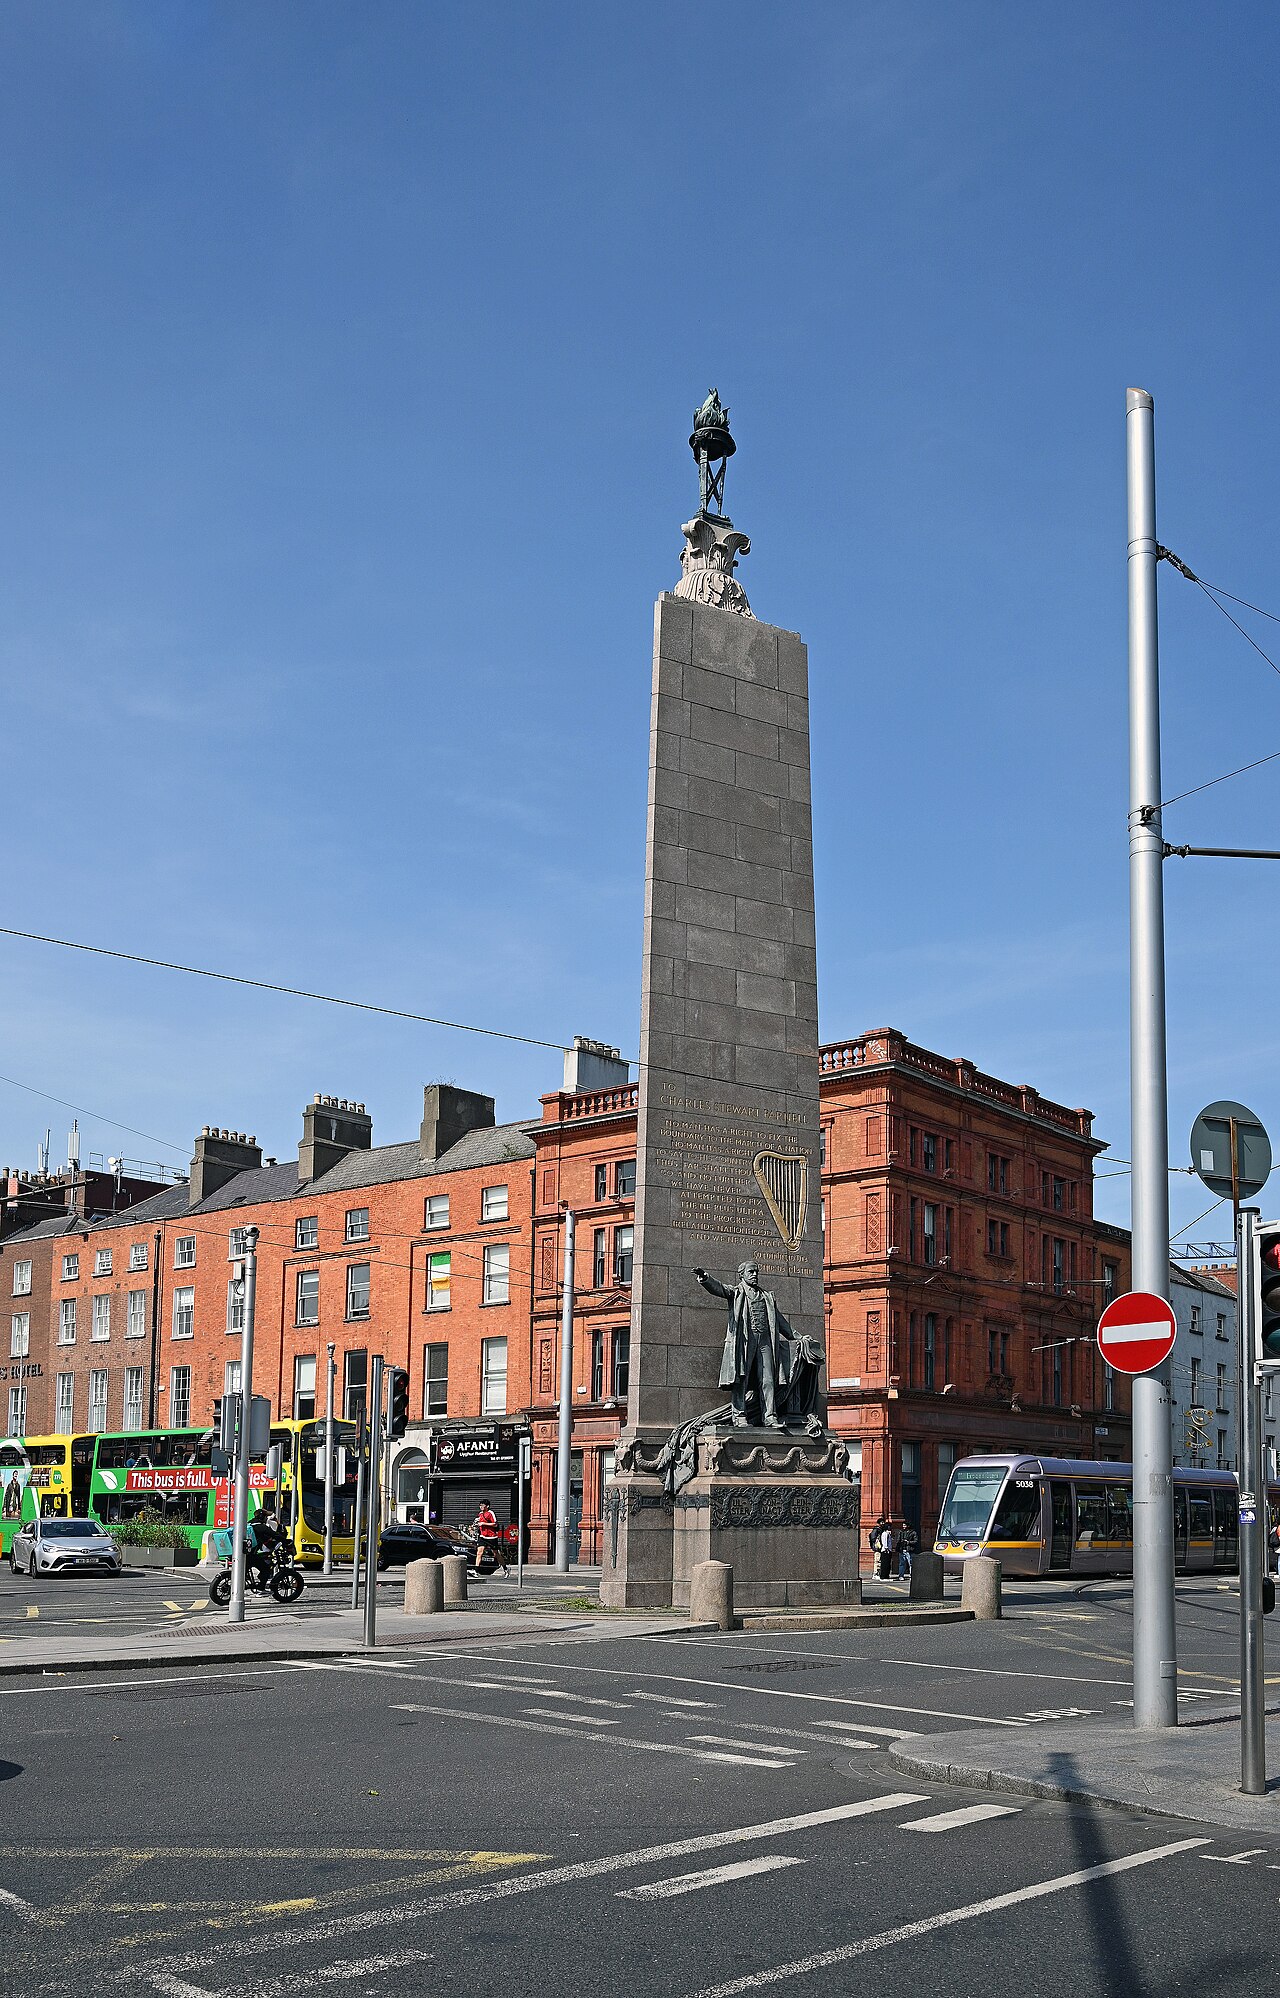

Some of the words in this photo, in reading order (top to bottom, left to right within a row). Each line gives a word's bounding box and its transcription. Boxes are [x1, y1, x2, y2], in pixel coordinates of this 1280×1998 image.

[662, 1082, 676, 1092] TO
[660, 1095, 711, 1110] CHARLES
[714, 1102, 760, 1117] STEWART
[764, 1108, 808, 1123] PARNELL
[665, 1120, 680, 1128] NO
[681, 1121, 701, 1130] MAN
[704, 1124, 720, 1133] HAS
[730, 1128, 753, 1137] RIGHT
[756, 1131, 767, 1139] TO
[768, 1132, 782, 1141] FIX
[784, 1134, 798, 1143] THE
[660, 1128, 705, 1141] BOUNDARY
[708, 1135, 718, 1143] TO
[719, 1136, 734, 1145] THE
[735, 1139, 762, 1148] MARCH
[764, 1142, 775, 1150] OF
[785, 1146, 812, 1155] NATION
[656, 1148, 667, 1156] TO
[686, 1142, 705, 1151] MAN
[706, 1144, 722, 1153] HAS
[731, 1148, 754, 1157] RIGHT
[655, 1158, 678, 1167] THUS
[683, 1161, 699, 1169] FAR
[678, 1171, 697, 1179] AND
[699, 1173, 712, 1182] NO
[686, 1182, 709, 1191] HAVE
[713, 1185, 741, 1194] NEVER
[680, 1191, 733, 1203] ATTEMPTED
[735, 1196, 747, 1205] TO
[681, 1201, 697, 1209] THE
[713, 1204, 734, 1213] PLUS
[736, 1206, 765, 1216] ULTRA
[681, 1211, 692, 1219] TO
[694, 1212, 711, 1221] THE
[713, 1214, 756, 1225] PROGRESS
[689, 1232, 710, 1241] AND
[11, 1363, 43, 1379] HOTEL
[131, 1472, 153, 1488] This
[154, 1471, 174, 1487] bus
[175, 1471, 185, 1487] is
[186, 1470, 208, 1487] full.
[1016, 1480, 1034, 1488] 5038
